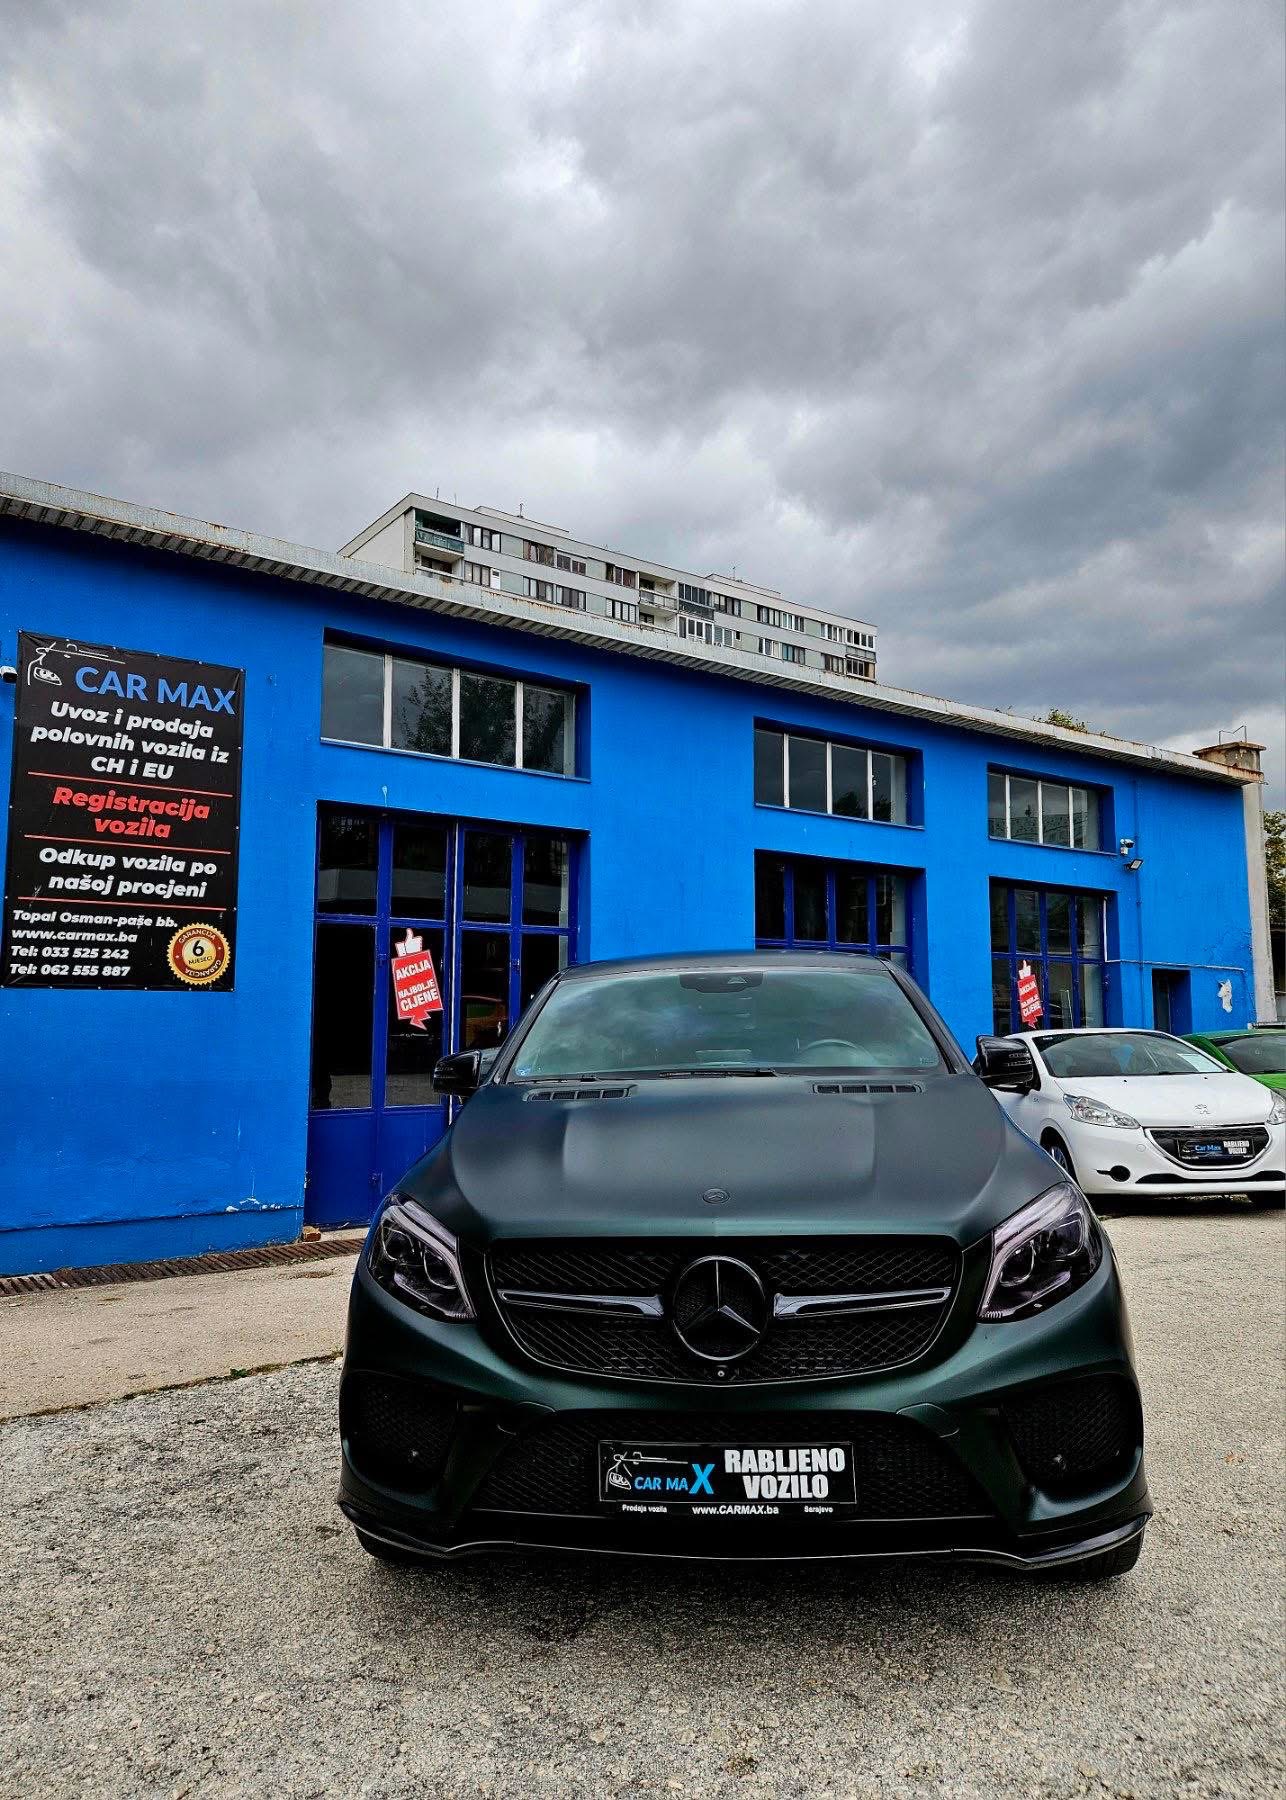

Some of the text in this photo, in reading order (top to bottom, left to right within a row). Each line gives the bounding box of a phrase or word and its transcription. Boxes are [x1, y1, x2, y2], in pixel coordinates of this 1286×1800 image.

[75, 666, 236, 715] CAR MAX
[50, 701, 214, 739] Uvoz i prodaja
[30, 725, 230, 764] polovnih vozila iz
[90, 756, 174, 780] CH i EU
[53, 786, 211, 821] Registracija
[94, 817, 171, 838] vozila
[39, 847, 217, 877] Odkup vozila po
[48, 874, 208, 899] našoj procjeni
[13, 909, 178, 928] Topal Osman-paše bb.
[11, 928, 138, 943] www.carmax.ba
[178, 929, 216, 943] GARANCIJA
[11, 945, 129, 960] Tel: 033 525 242
[193, 940, 204, 957] 6
[10, 963, 131, 977] Tel: 062 555 887
[395, 959, 431, 980] AKCIJA
[398, 978, 435, 999] NAJBOLJE
[400, 988, 438, 1012] CIJENE
[724, 1447, 845, 1473] RABLJENO
[634, 1476, 662, 1491] CAR
[742, 1474, 829, 1499] VOZILO
[622, 1504, 647, 1513] Prodaja
[692, 1504, 779, 1515] www.CARMAX.ba
